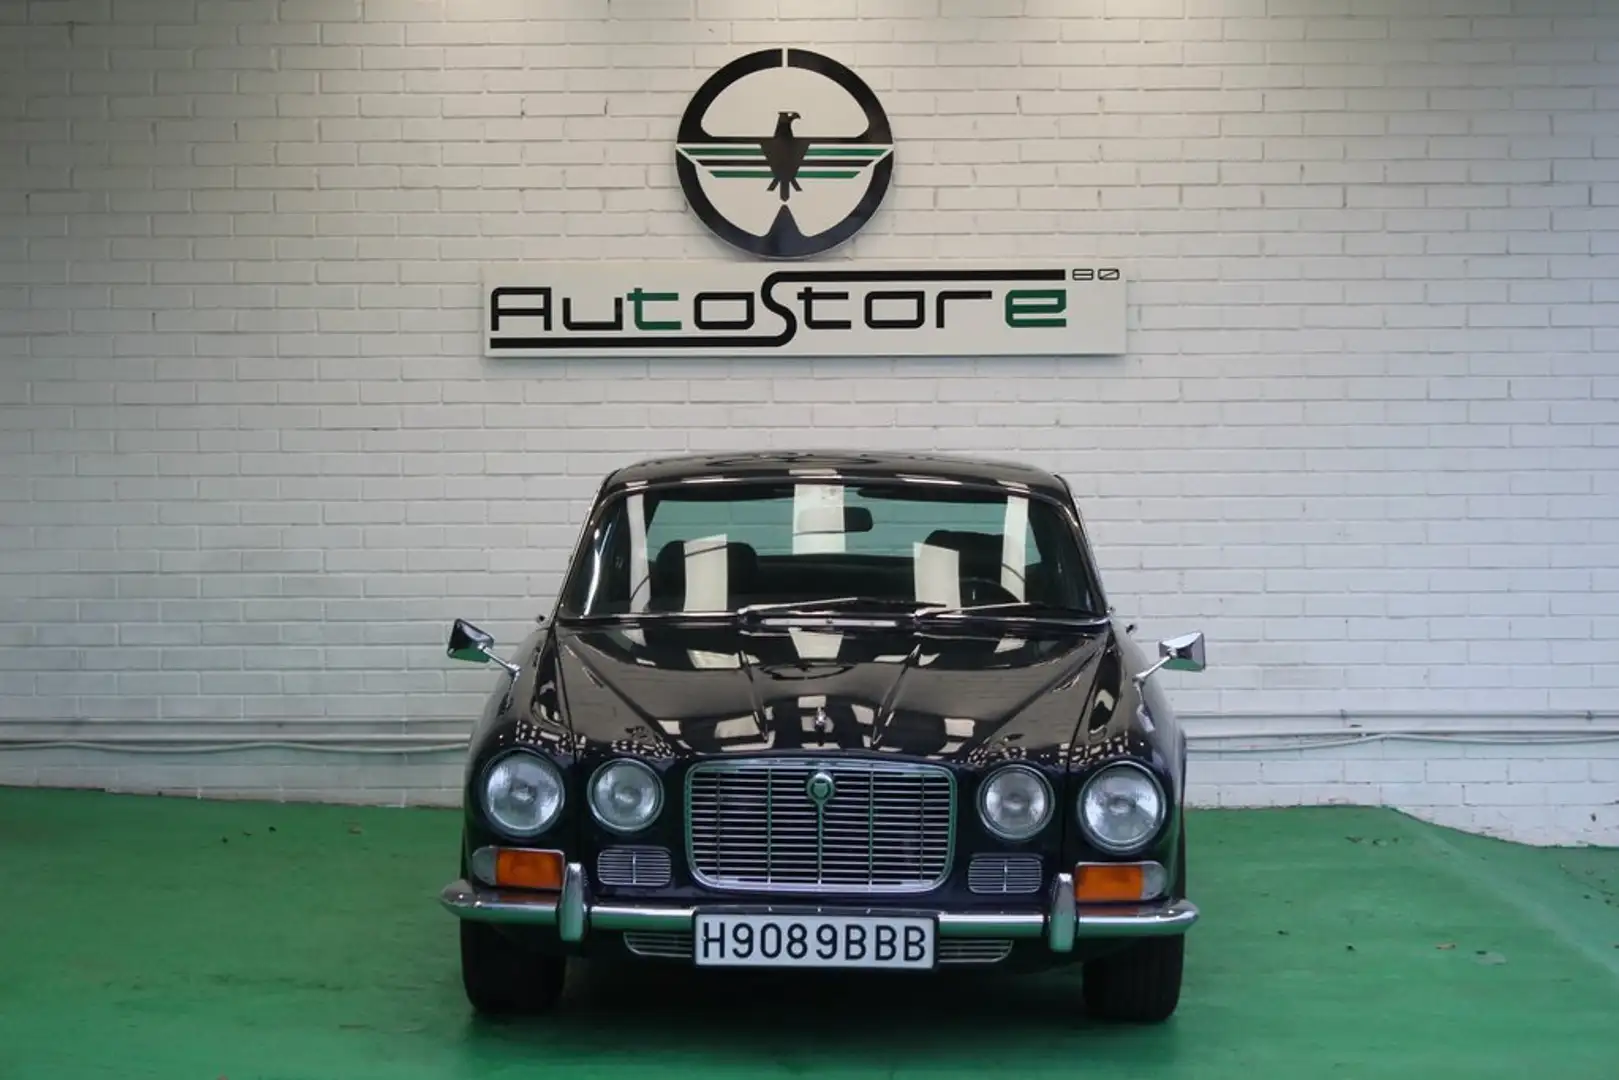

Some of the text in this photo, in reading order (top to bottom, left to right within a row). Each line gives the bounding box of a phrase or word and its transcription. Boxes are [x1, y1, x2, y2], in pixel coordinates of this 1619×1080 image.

[490, 268, 1120, 348] AutoStore 80
[703, 922, 925, 961] H9089BBB
